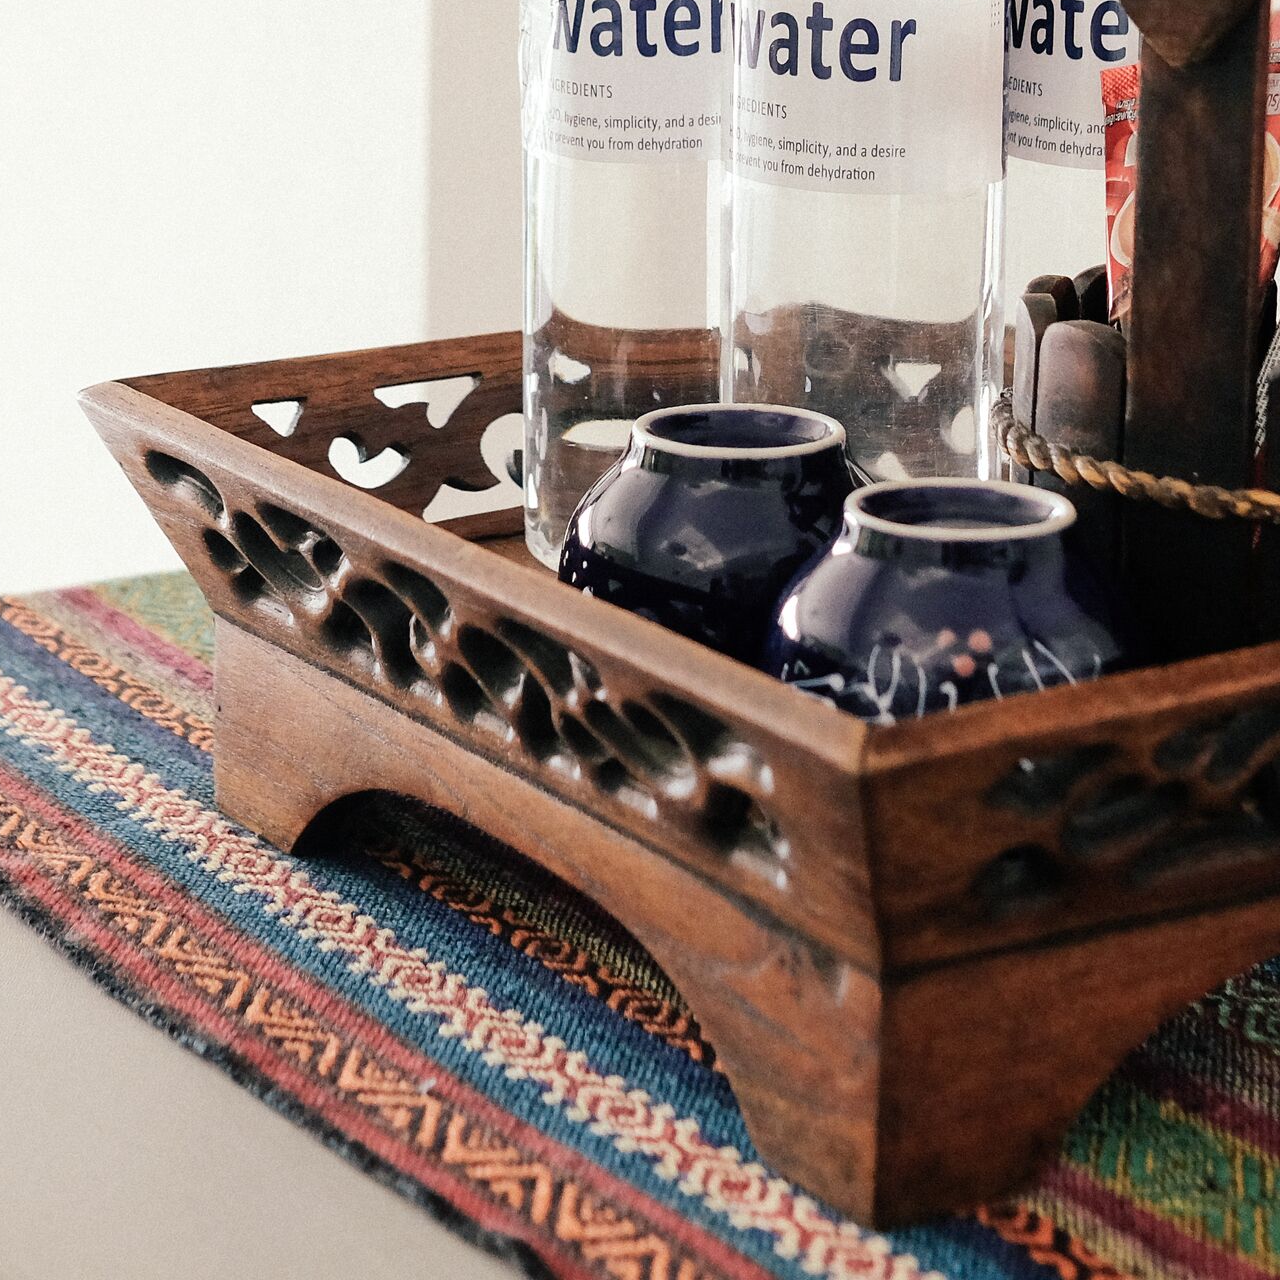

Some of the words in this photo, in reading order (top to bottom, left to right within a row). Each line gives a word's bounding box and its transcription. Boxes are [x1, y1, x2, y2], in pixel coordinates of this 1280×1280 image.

[604, 114, 662, 132] simplicity,
[664, 114, 686, 129] and
[688, 117, 695, 128] a
[1033, 113, 1083, 136] simplicity,
[586, 137, 606, 152] you
[608, 135, 635, 151] from
[637, 137, 704, 154] dehydration
[778, 136, 832, 159] simplicity,
[835, 143, 858, 158] and
[860, 146, 868, 158] a
[870, 144, 907, 159] desire
[1017, 135, 1033, 148] you
[1035, 135, 1057, 152] from
[1059, 140, 1104, 158] dehydra
[762, 159, 779, 173] you
[781, 159, 805, 176] from
[807, 162, 876, 182] dehydration
